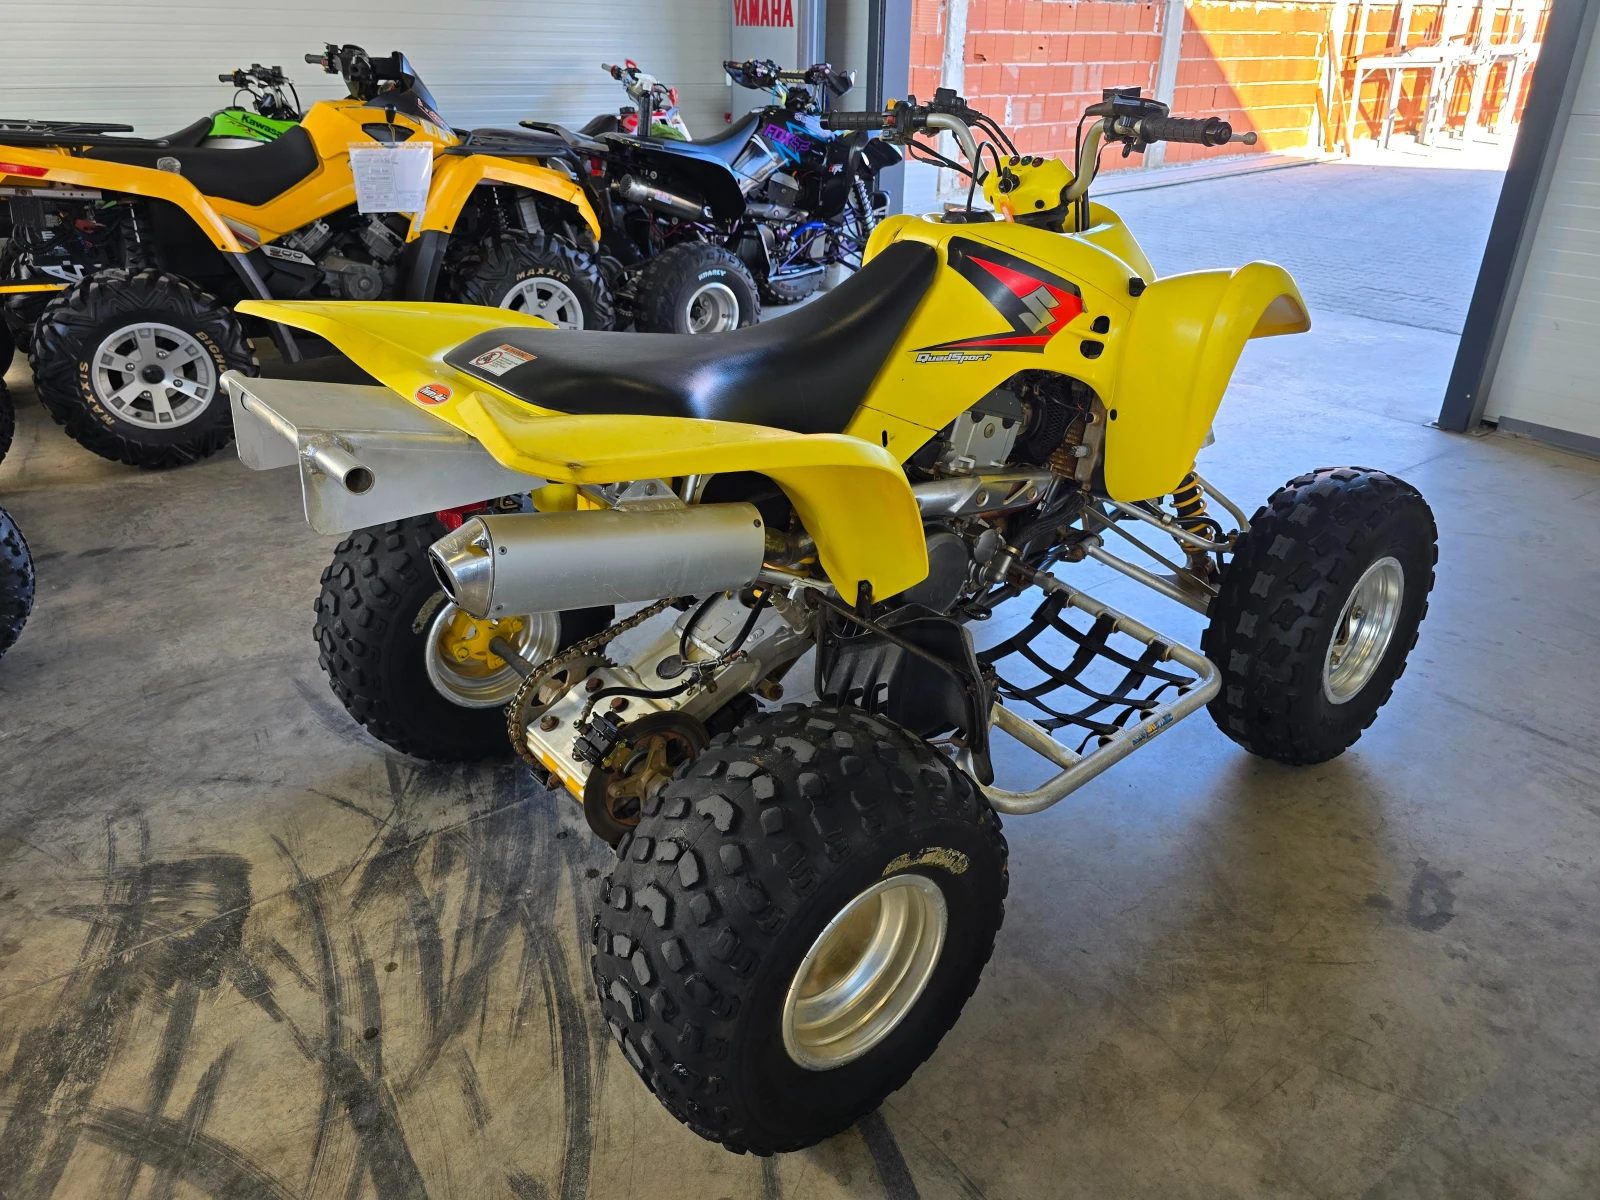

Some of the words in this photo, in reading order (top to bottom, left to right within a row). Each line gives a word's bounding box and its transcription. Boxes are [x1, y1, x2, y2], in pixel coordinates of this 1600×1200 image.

[733, 0, 794, 27] YAMAHA
[241, 114, 283, 138] Kawasa
[763, 123, 795, 147] FOX
[515, 267, 571, 282] MAXXIS
[915, 352, 992, 364] QuadSport
[79, 361, 115, 426] MAXXIS
